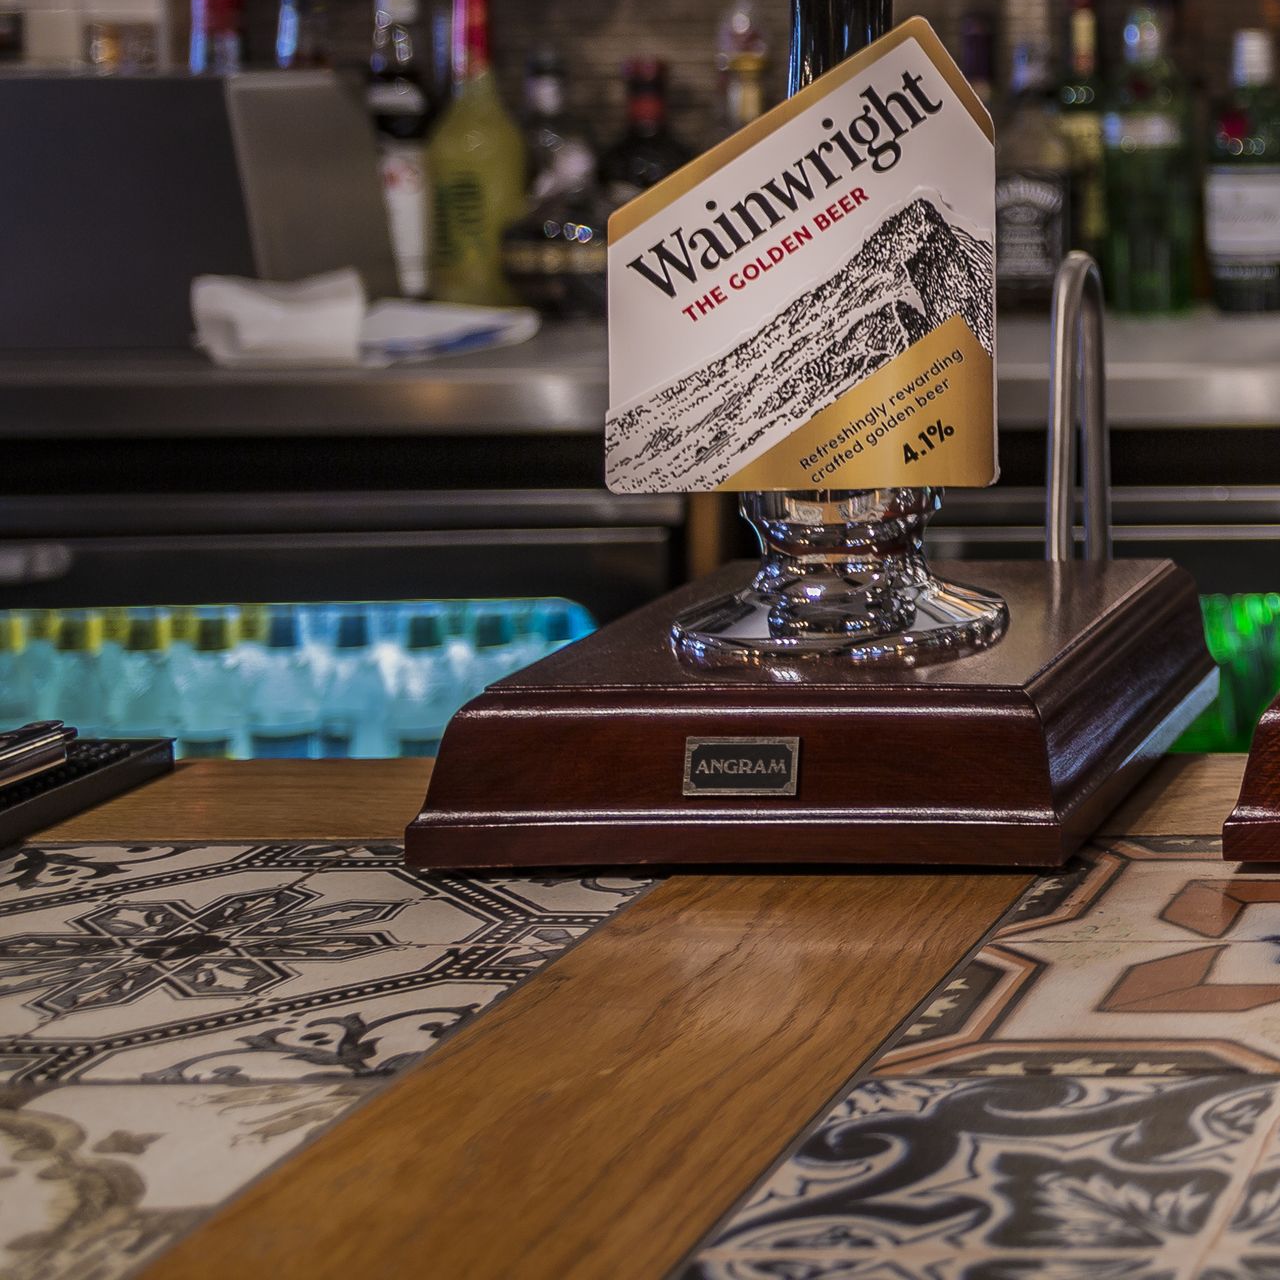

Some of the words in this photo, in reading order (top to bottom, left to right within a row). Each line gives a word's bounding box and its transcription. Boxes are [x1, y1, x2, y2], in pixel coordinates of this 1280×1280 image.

[626, 70, 944, 299] Wainwright
[682, 286, 728, 322] THE
[729, 225, 813, 290] GOLDEN
[812, 187, 870, 232] BEER
[799, 401, 888, 470] Refreshingly
[889, 348, 965, 407] rewarding
[811, 441, 864, 484] crafted
[865, 403, 917, 447] golden
[915, 377, 952, 408] beer
[902, 419, 955, 465] 4.1%
[695, 759, 787, 774] ANGRAM
